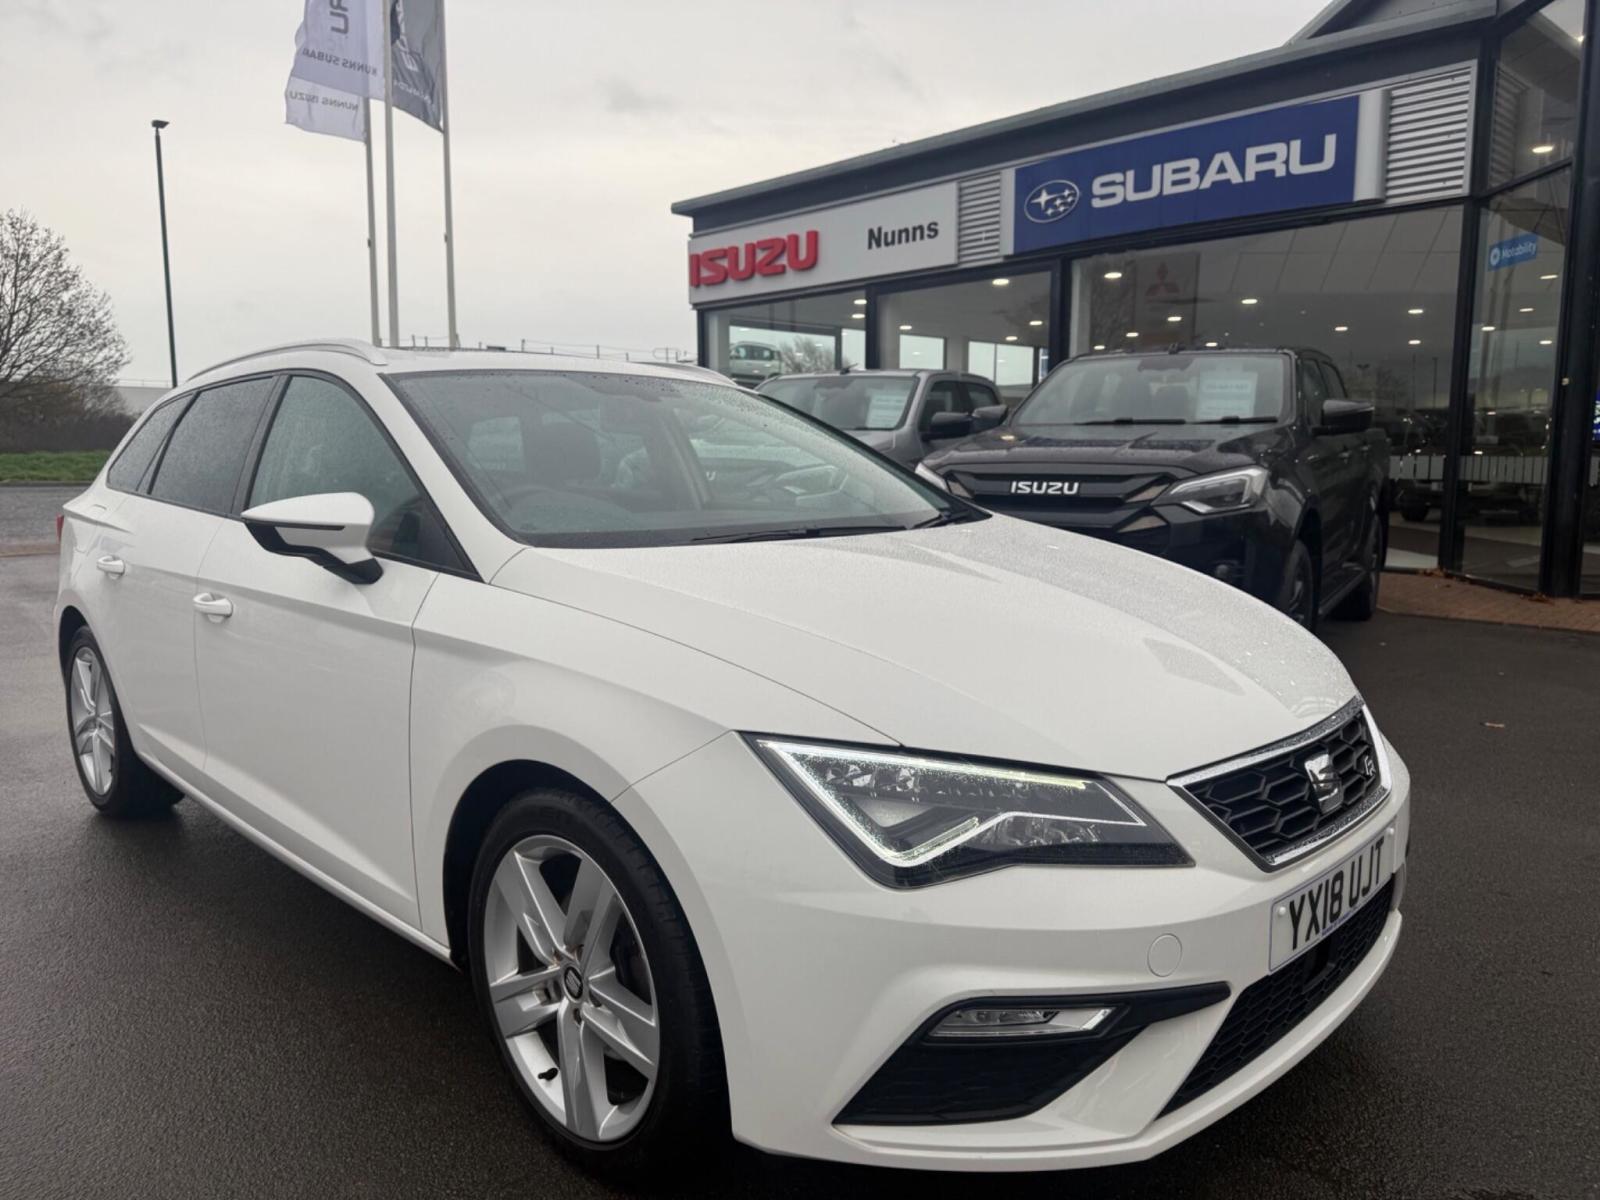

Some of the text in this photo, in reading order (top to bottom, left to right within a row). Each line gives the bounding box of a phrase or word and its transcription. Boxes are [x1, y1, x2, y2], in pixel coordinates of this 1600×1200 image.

[1091, 133, 1337, 209] SUBARU
[690, 230, 819, 288] ISUZU
[867, 221, 939, 251] Nunns
[1010, 481, 1079, 495] ISUZU
[1289, 870, 1344, 951] YX18
[1348, 838, 1385, 908] UJT
